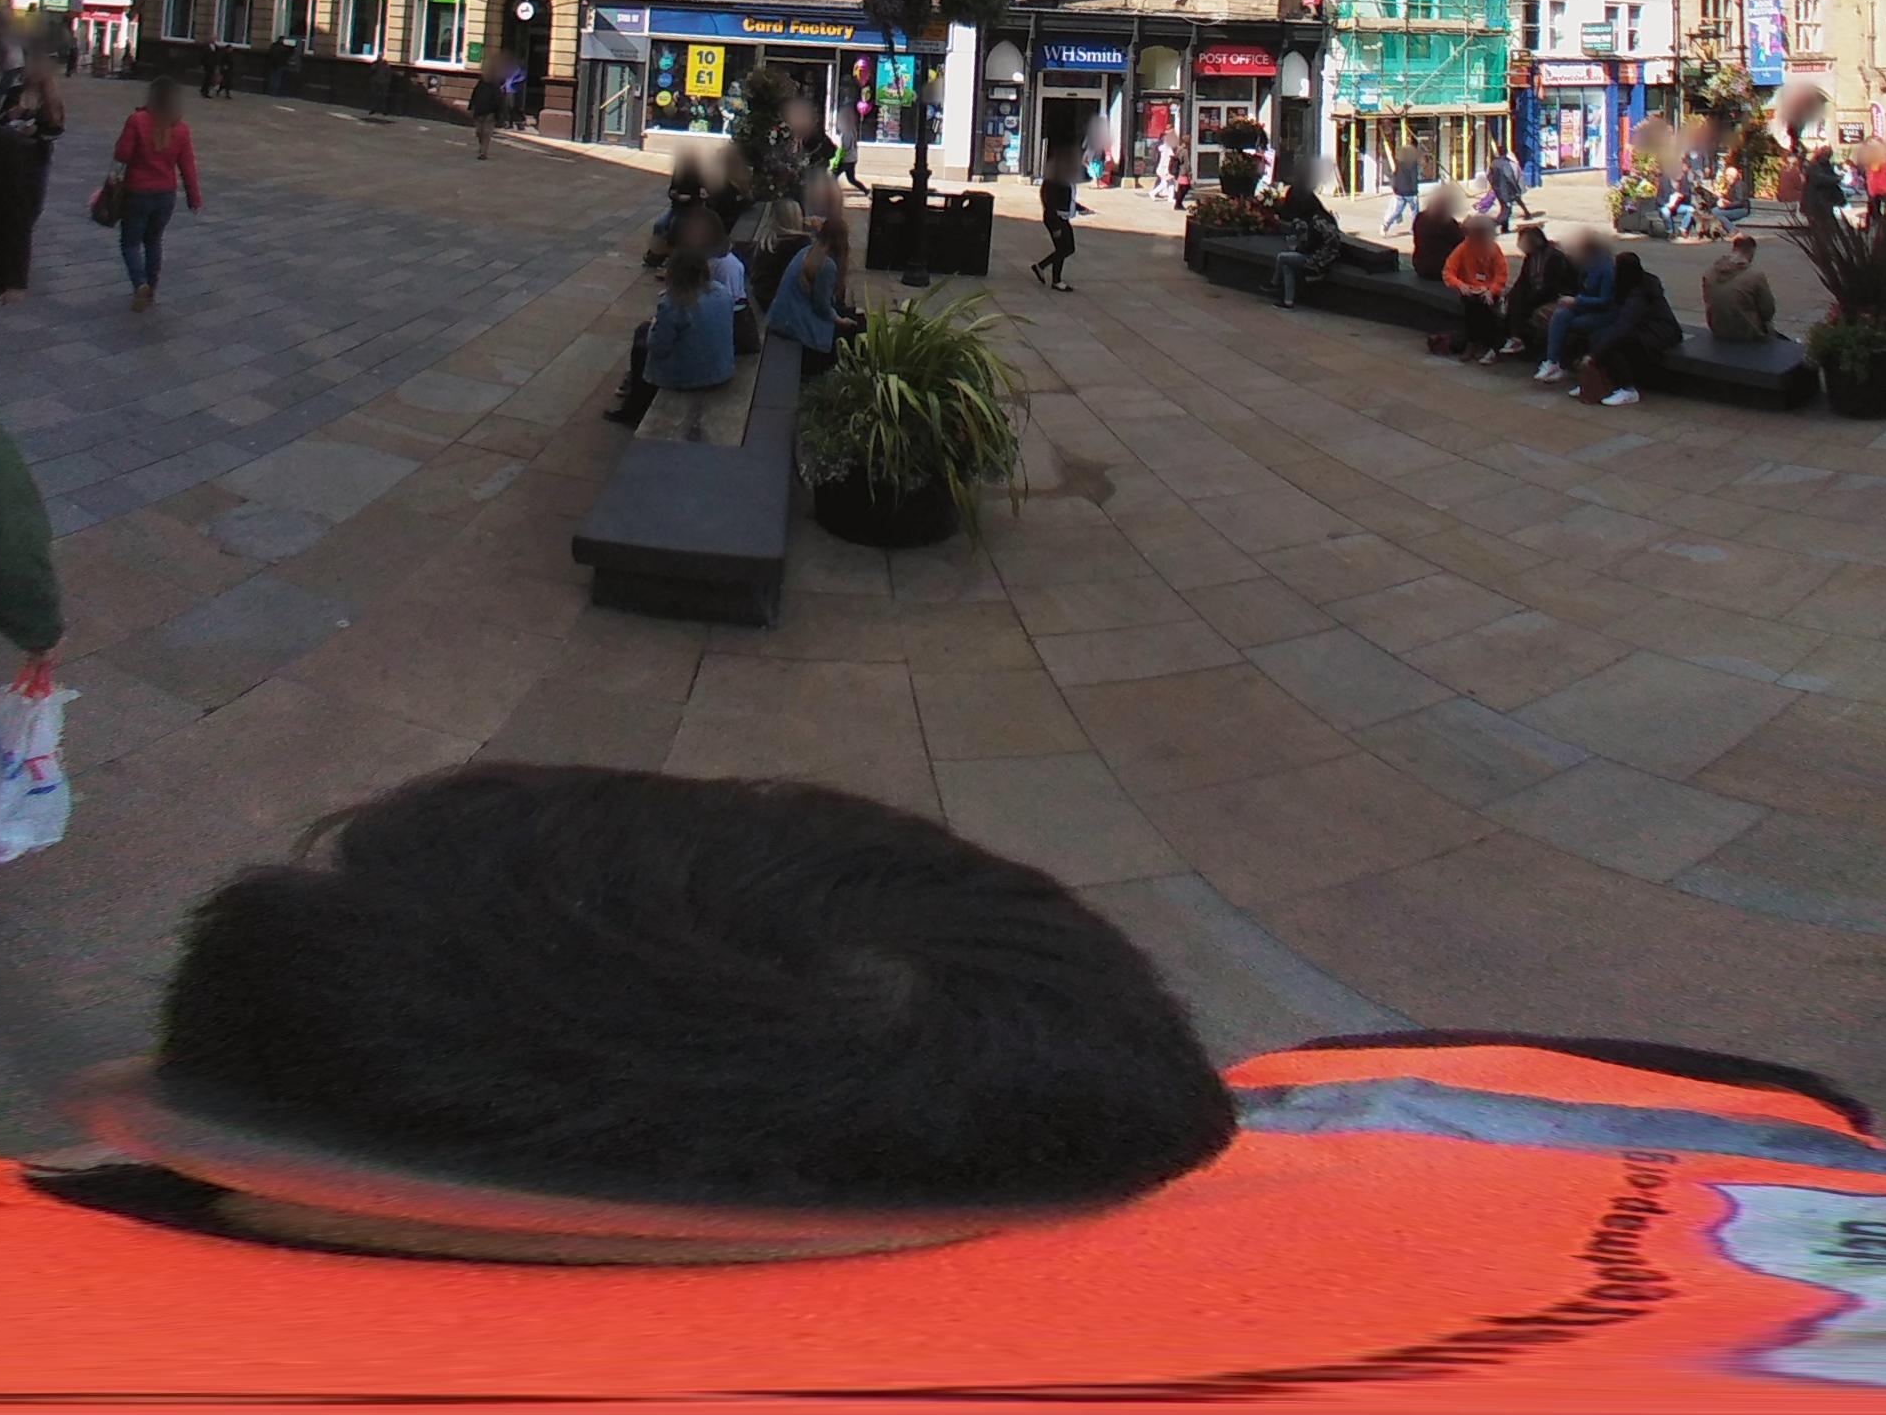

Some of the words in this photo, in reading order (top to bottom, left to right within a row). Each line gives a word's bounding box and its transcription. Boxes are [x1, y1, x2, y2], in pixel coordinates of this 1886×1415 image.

[742, 17, 784, 34] Card
[789, 20, 855, 40] Factory
[696, 50, 716, 65] 10
[1044, 45, 1123, 63] WHSmith
[1198, 52, 1228, 64] POST
[1229, 52, 1270, 66] OFFICE
[695, 70, 715, 85] £1
